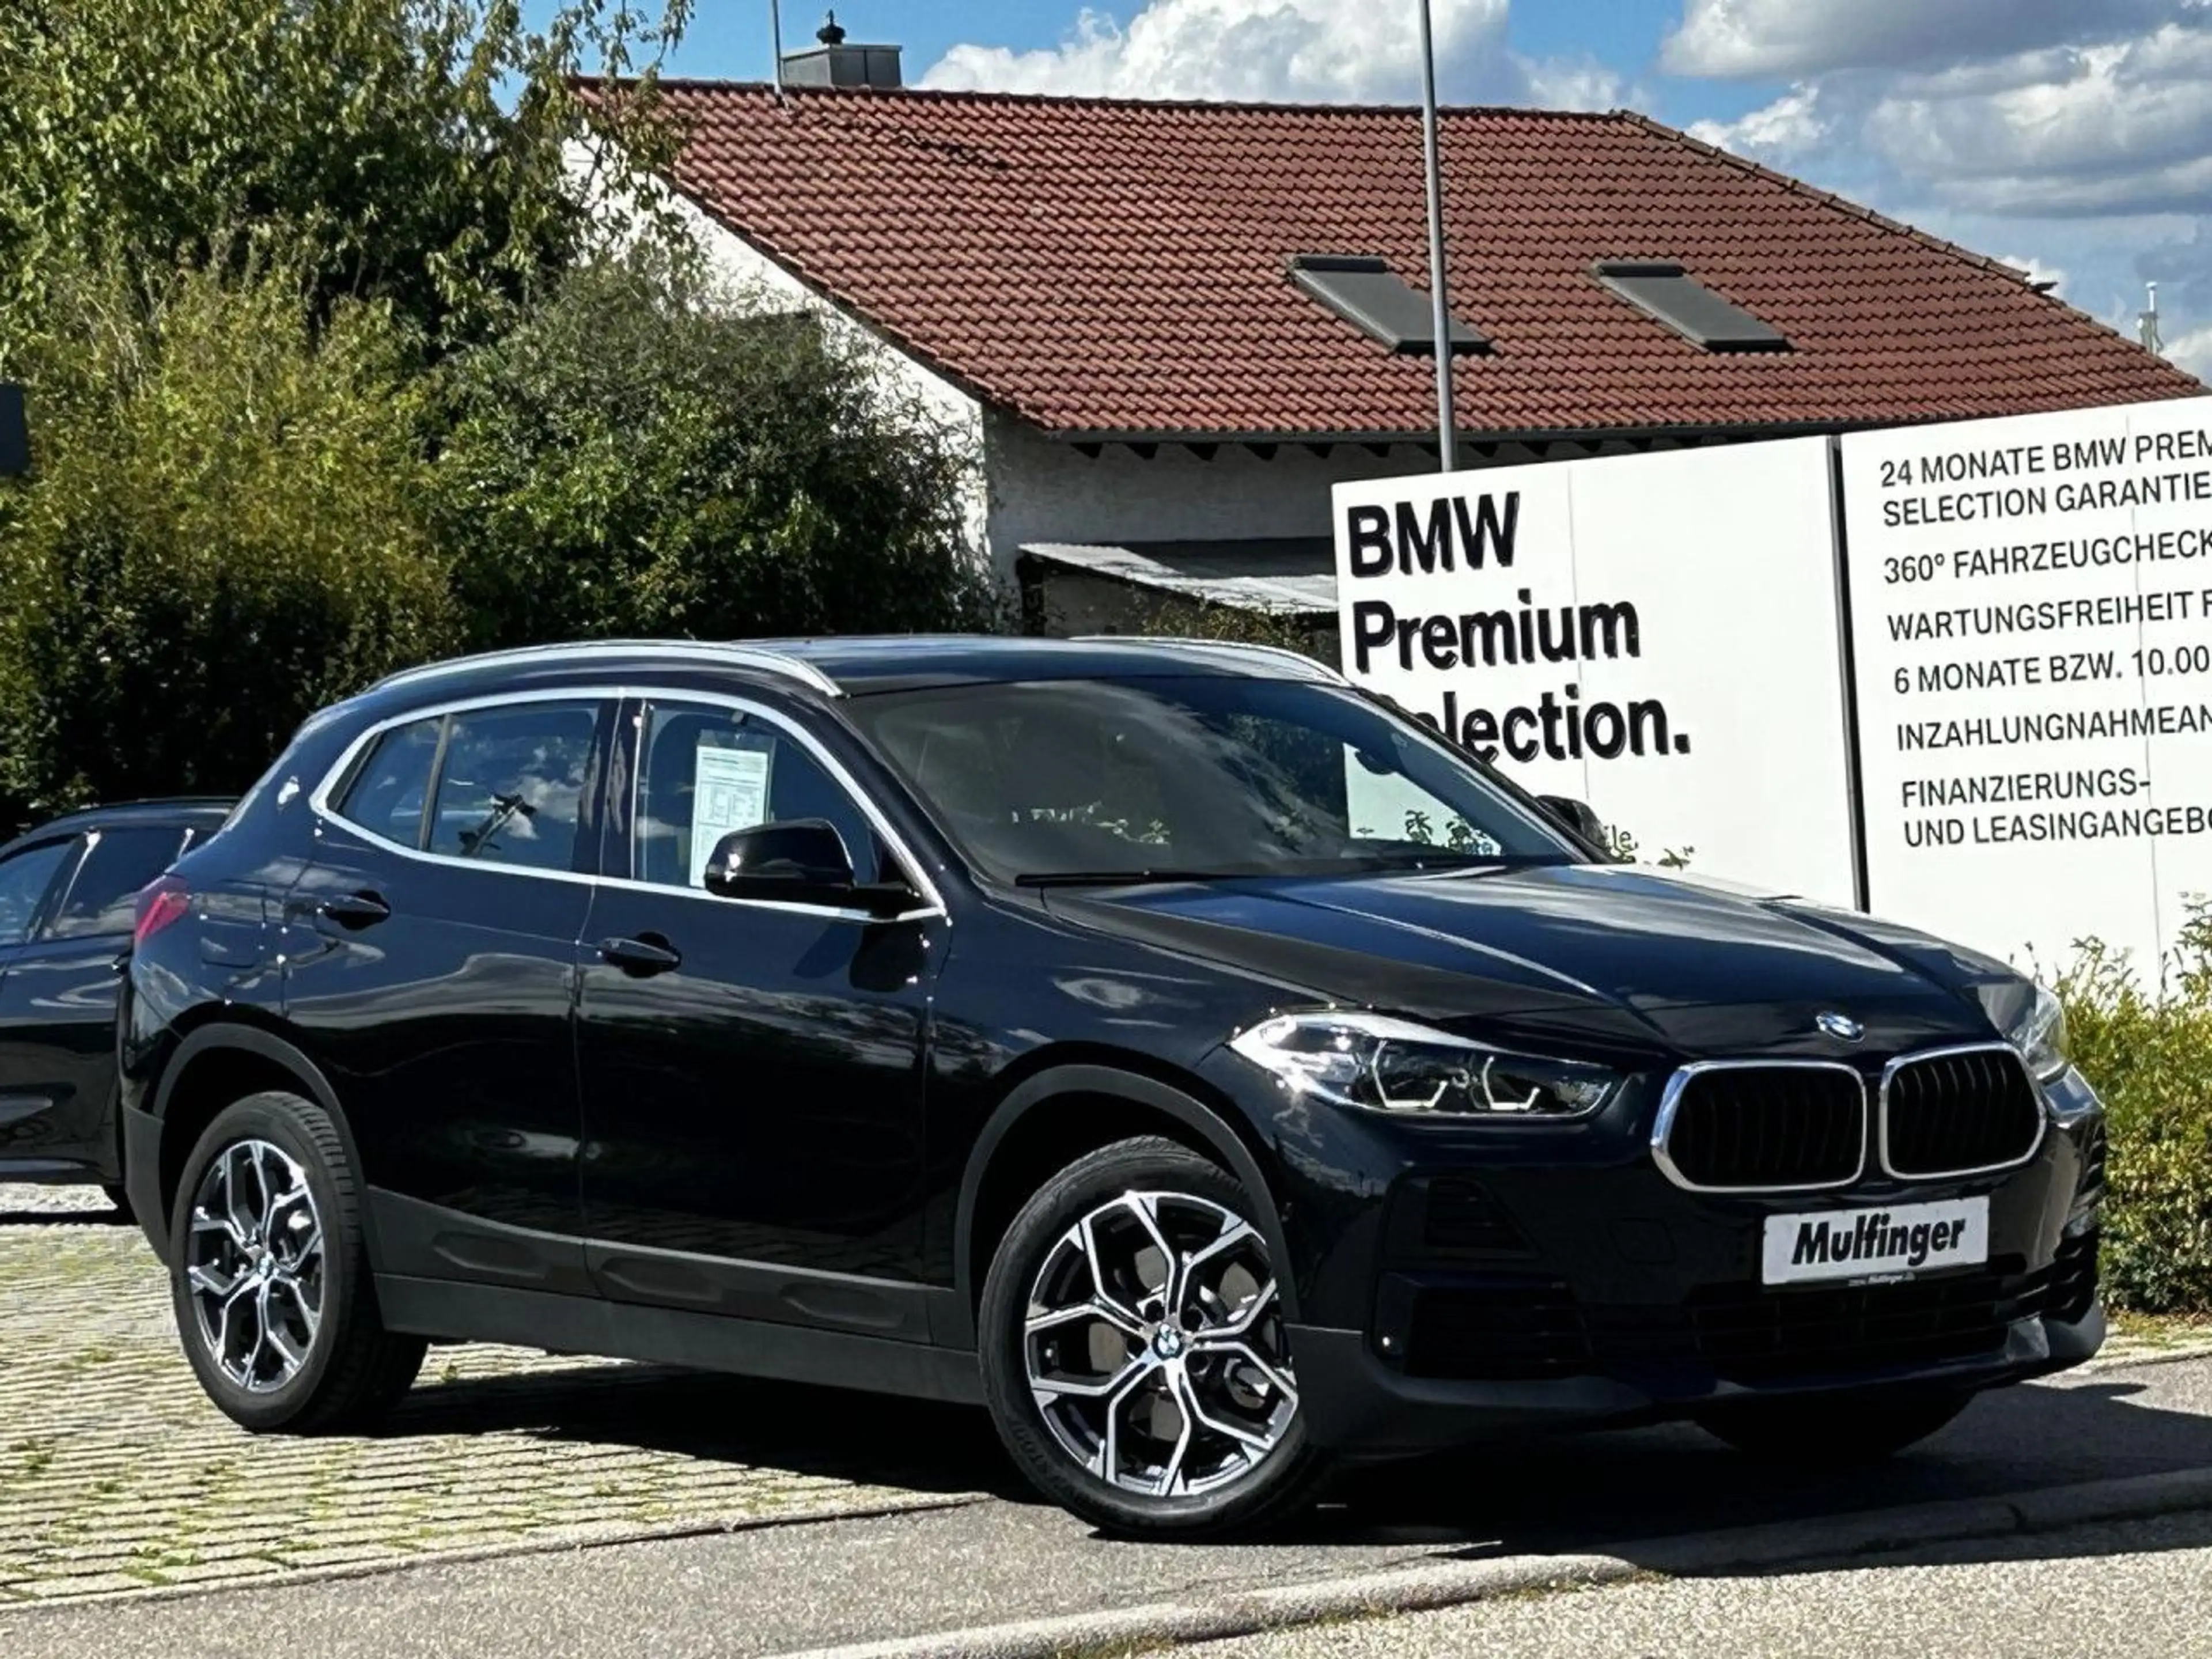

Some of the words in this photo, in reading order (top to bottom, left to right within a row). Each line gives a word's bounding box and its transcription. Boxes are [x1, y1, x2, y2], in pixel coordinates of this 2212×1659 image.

[1880, 460, 1913, 487] 24
[1921, 446, 2045, 484] MONATE
[2052, 437, 2127, 471] BMW
[1883, 487, 2046, 527] SELECTION
[2055, 471, 2212, 512] GARANTIE
[1347, 490, 1520, 578] BMW
[1353, 588, 1641, 674] Premium
[1887, 590, 2194, 641] WARTUNGSFREIHEIT
[1894, 667, 1910, 694] 6
[1918, 657, 2041, 692] MONATE
[2050, 650, 2123, 682] BZW.
[2131, 645, 2210, 677] 10.00
[1414, 683, 1691, 763] lection.
[1902, 768, 2151, 808] FINANZIERUNGS-
[1904, 819, 1965, 847] UND
[1791, 1213, 1967, 1266] Mulfinger
